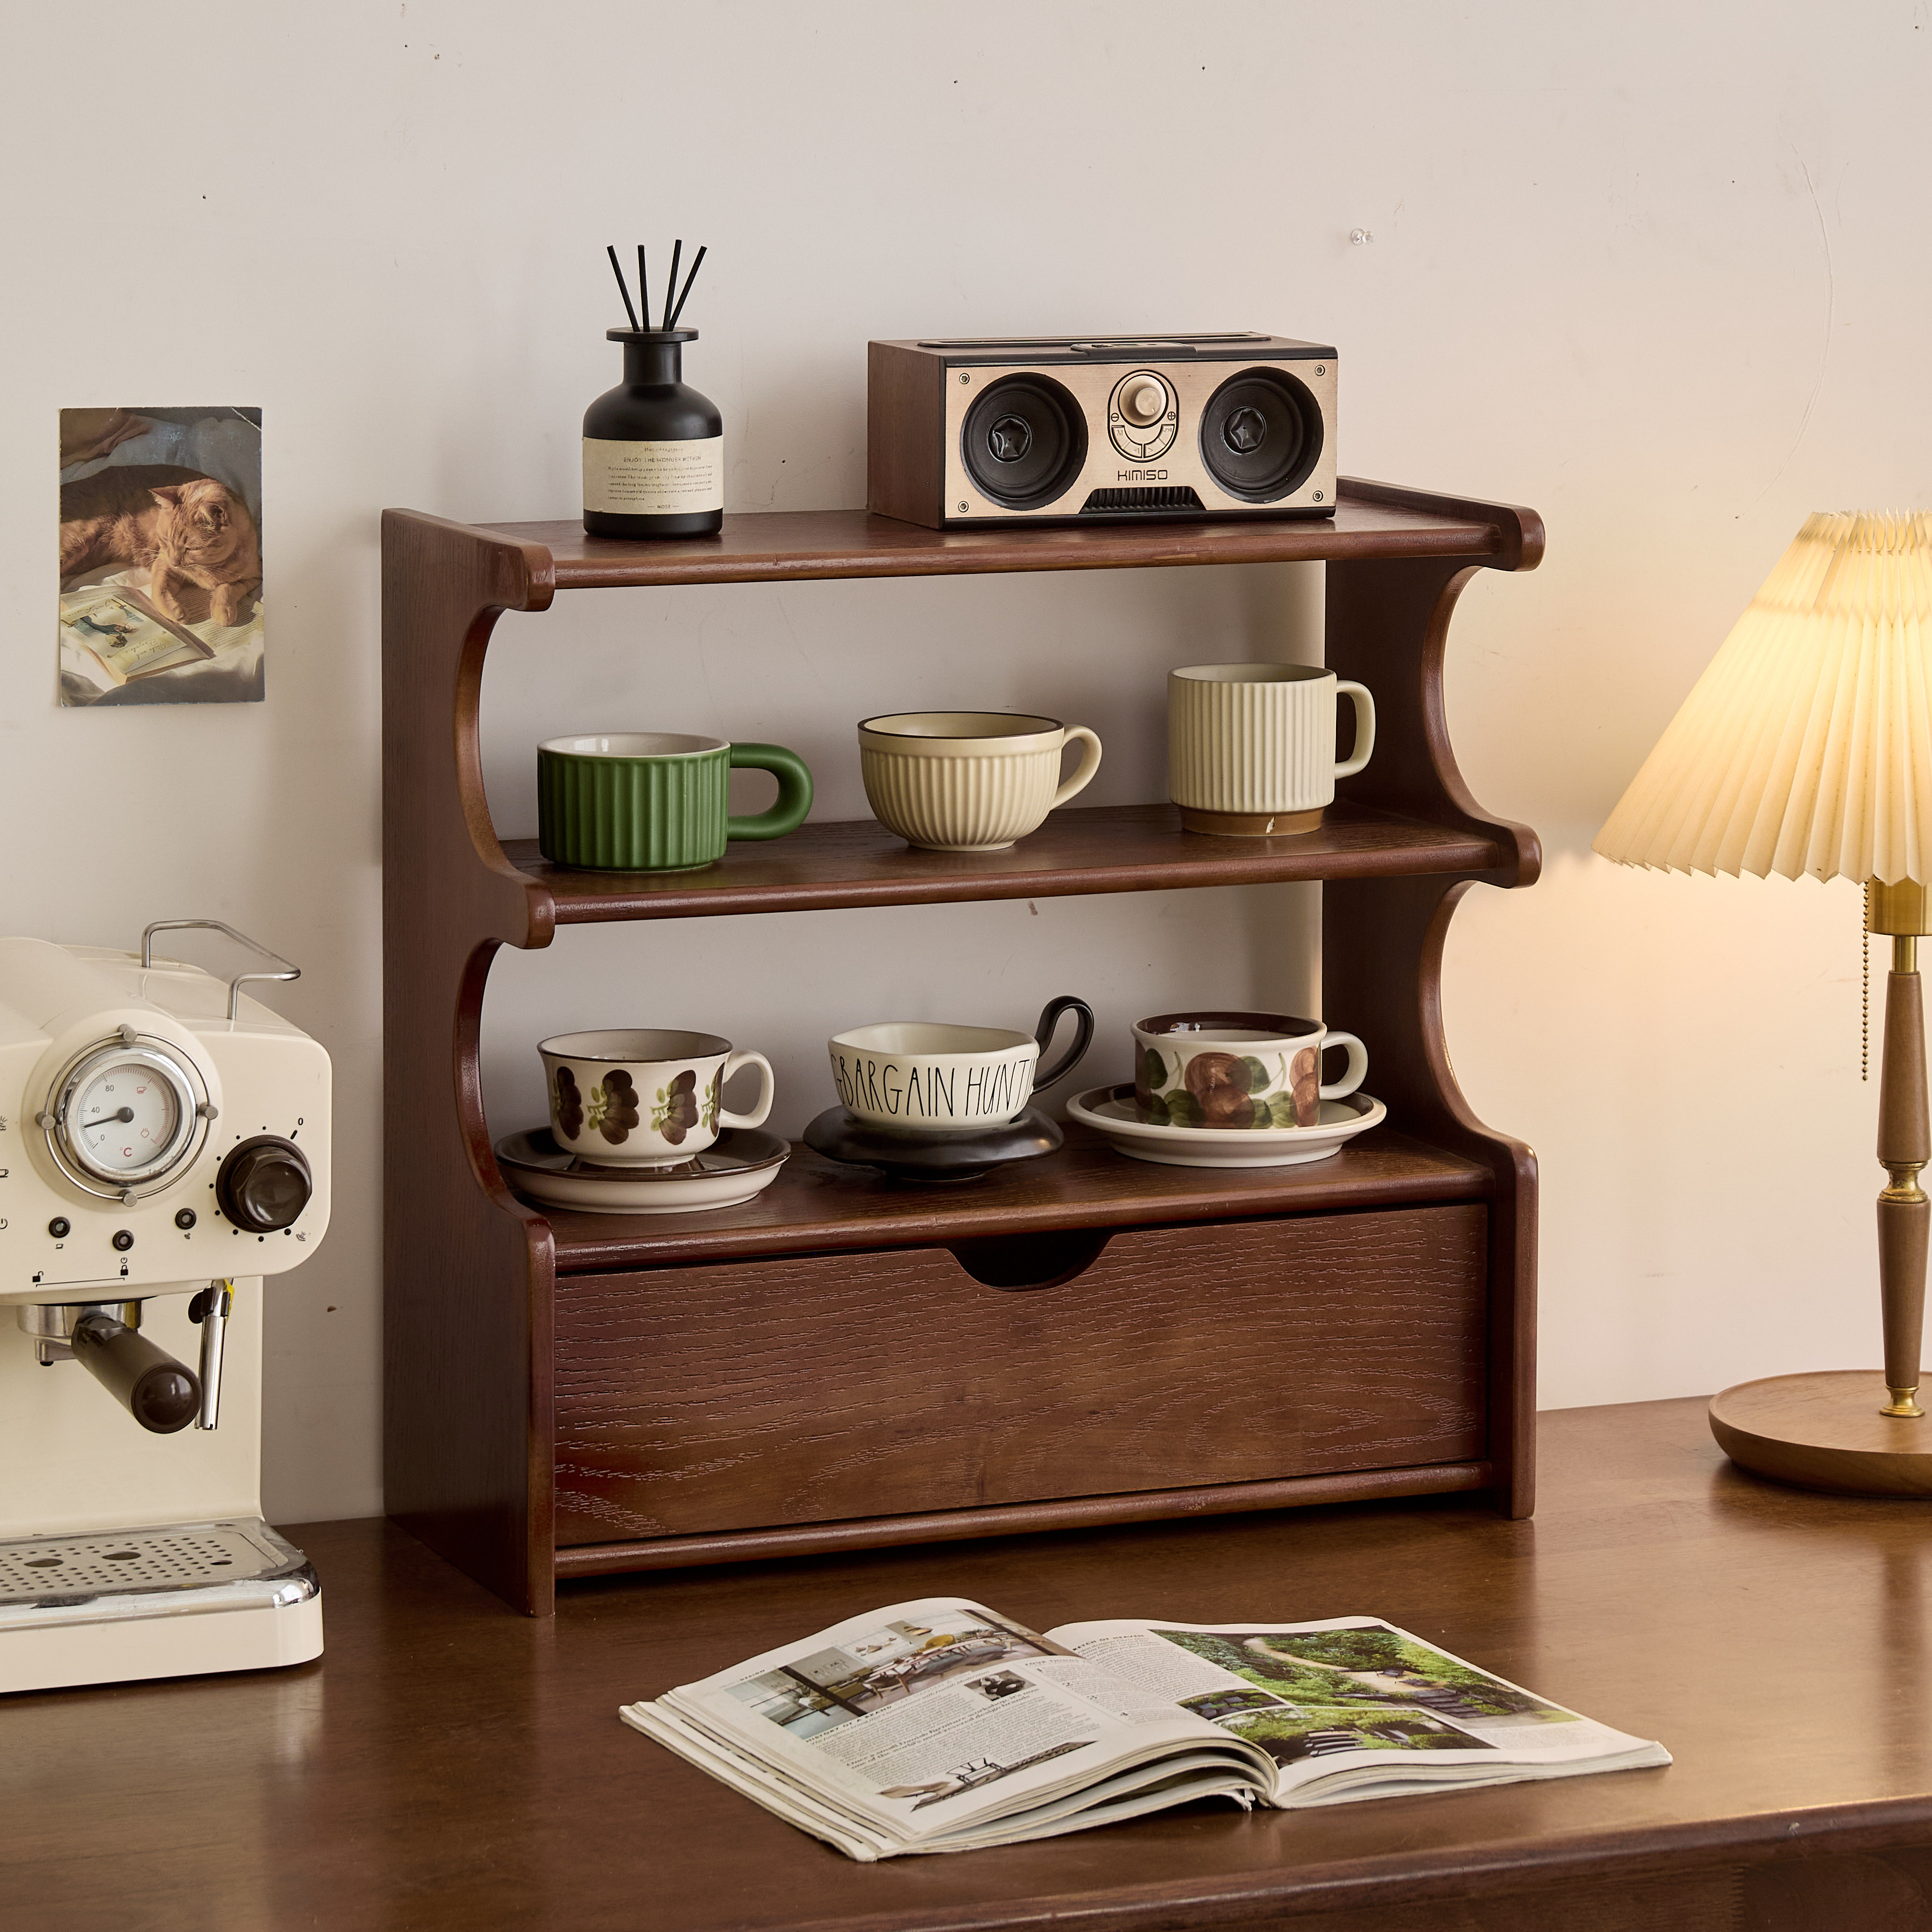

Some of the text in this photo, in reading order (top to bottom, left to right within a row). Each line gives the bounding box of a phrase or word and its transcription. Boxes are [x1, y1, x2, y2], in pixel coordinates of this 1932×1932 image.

[1118, 470, 1168, 481] KIMISO
[840, 1056, 955, 1117] BARGAIN
[298, 1117, 304, 1125] 0
